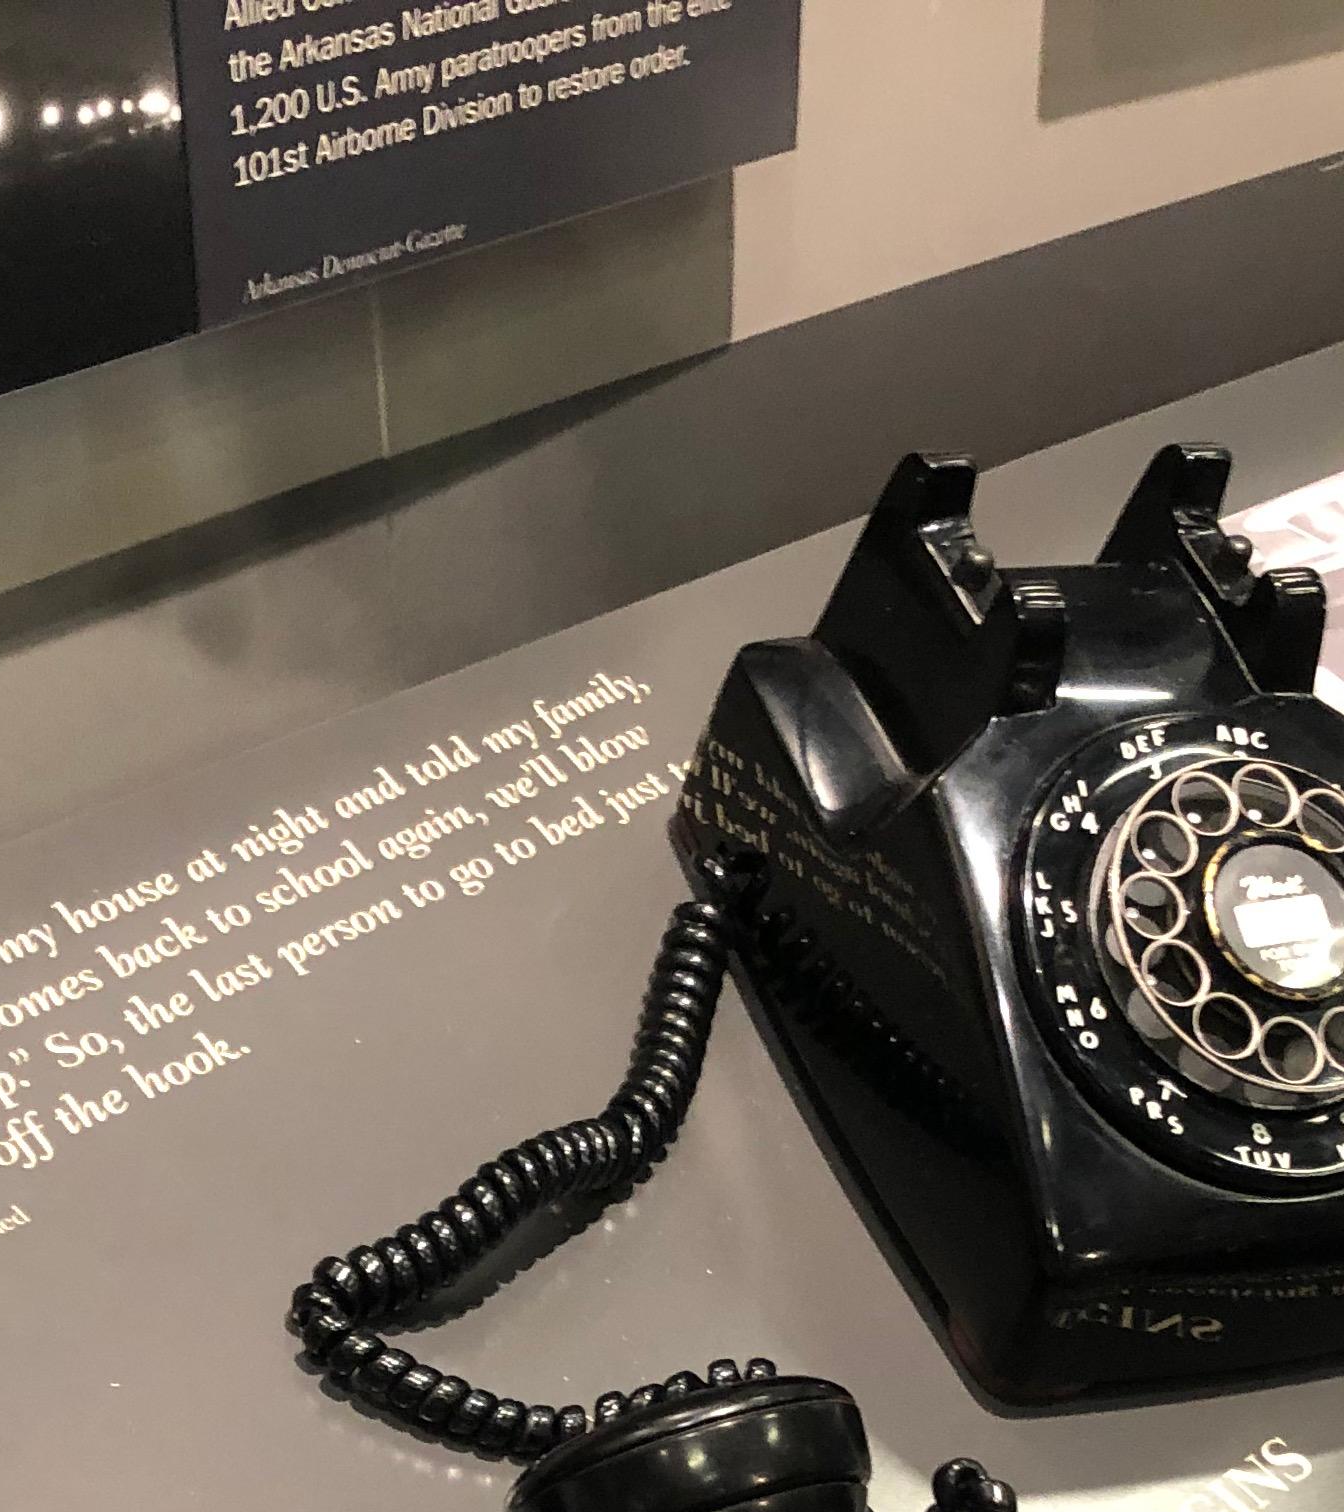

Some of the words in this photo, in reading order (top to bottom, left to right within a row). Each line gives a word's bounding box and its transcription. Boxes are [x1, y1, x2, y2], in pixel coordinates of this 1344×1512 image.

[227, 49, 272, 82] the
[278, 21, 395, 71] Arkansas
[401, 0, 499, 40] National
[229, 87, 310, 135] 1,200
[315, 74, 368, 112] U.S.
[373, 62, 435, 99] Army
[440, 24, 586, 87] paratroopers
[590, 9, 642, 42] from
[645, 0, 683, 28] the
[233, 141, 309, 186] 101st
[314, 117, 417, 164] Airborne
[422, 91, 513, 135] Division
[516, 82, 542, 109] to
[547, 62, 625, 101] restore
[629, 44, 691, 79] order.
[1120, 729, 1166, 760] DEF
[1215, 724, 1270, 750] ABC
[50, 872, 179, 934] house
[186, 849, 226, 882] at
[230, 806, 329, 861] night
[334, 766, 406, 818] and
[404, 734, 480, 786] told
[481, 719, 544, 759] my
[532, 672, 650, 749] family,
[1081, 812, 1100, 834] 4
[94, 916, 208, 978] back
[204, 904, 251, 933] to
[255, 839, 373, 913] school
[377, 805, 489, 860] again,
[484, 753, 568, 808] we'll
[556, 725, 649, 772] blow
[43, 1031, 125, 1068] So,
[122, 992, 194, 1035] the
[186, 953, 272, 1001] last
[276, 899, 402, 976] person
[400, 879, 445, 907] to
[448, 857, 494, 896] go
[493, 837, 536, 865] to
[526, 795, 604, 845] bed
[597, 772, 669, 824] just
[1060, 900, 1078, 923] 5
[1090, 997, 1106, 1019] 6
[53, 1089, 129, 1134] the
[120, 1031, 251, 1098] hook.
[1234, 1146, 1291, 1169] TUV
[1251, 1123, 1272, 1145] 8
